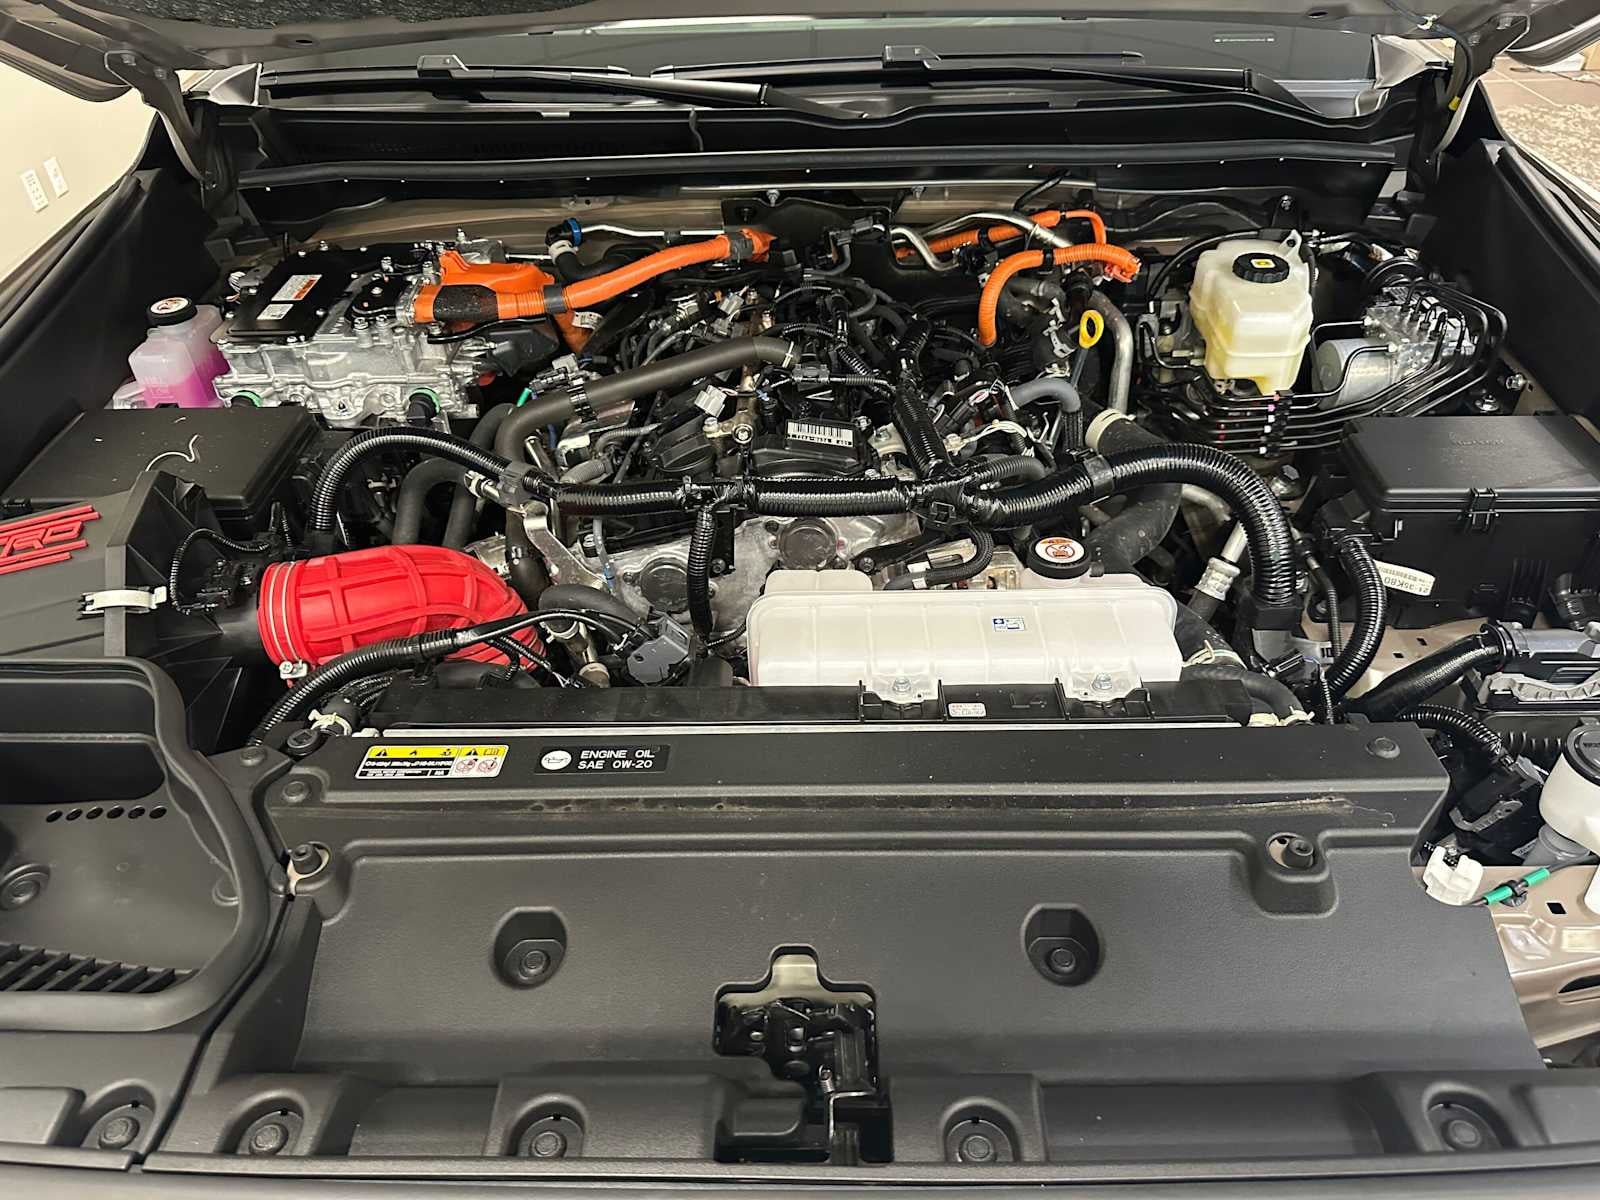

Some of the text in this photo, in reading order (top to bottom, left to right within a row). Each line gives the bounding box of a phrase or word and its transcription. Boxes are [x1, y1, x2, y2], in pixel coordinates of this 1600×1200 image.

[580, 749, 655, 759] ENGINE OIL
[577, 760, 653, 769] SAE 0W-20
